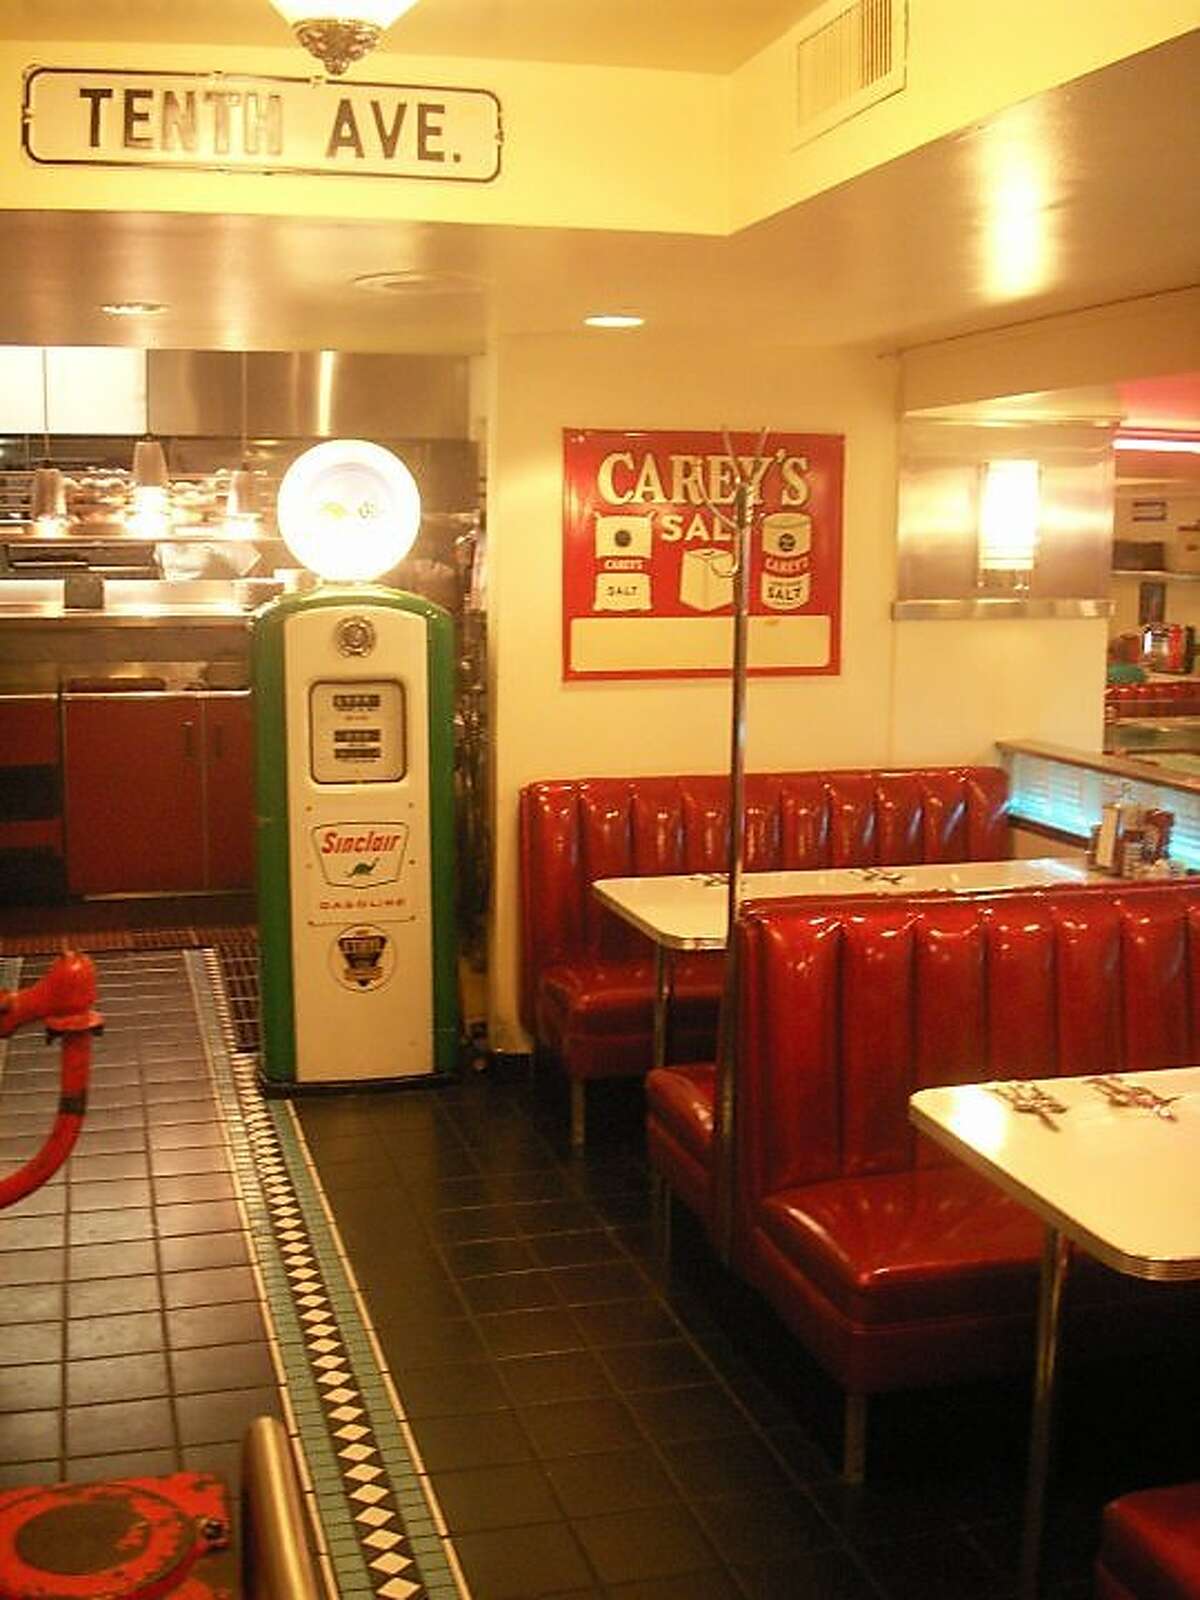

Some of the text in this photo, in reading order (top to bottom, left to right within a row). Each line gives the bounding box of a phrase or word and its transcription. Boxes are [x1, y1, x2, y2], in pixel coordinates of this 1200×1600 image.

[79, 87, 462, 164] TENTH AVE.
[598, 449, 811, 506] CAREY'S
[660, 512, 738, 542] SAL
[767, 586, 802, 601] SALT
[321, 829, 402, 855] Sinclair
